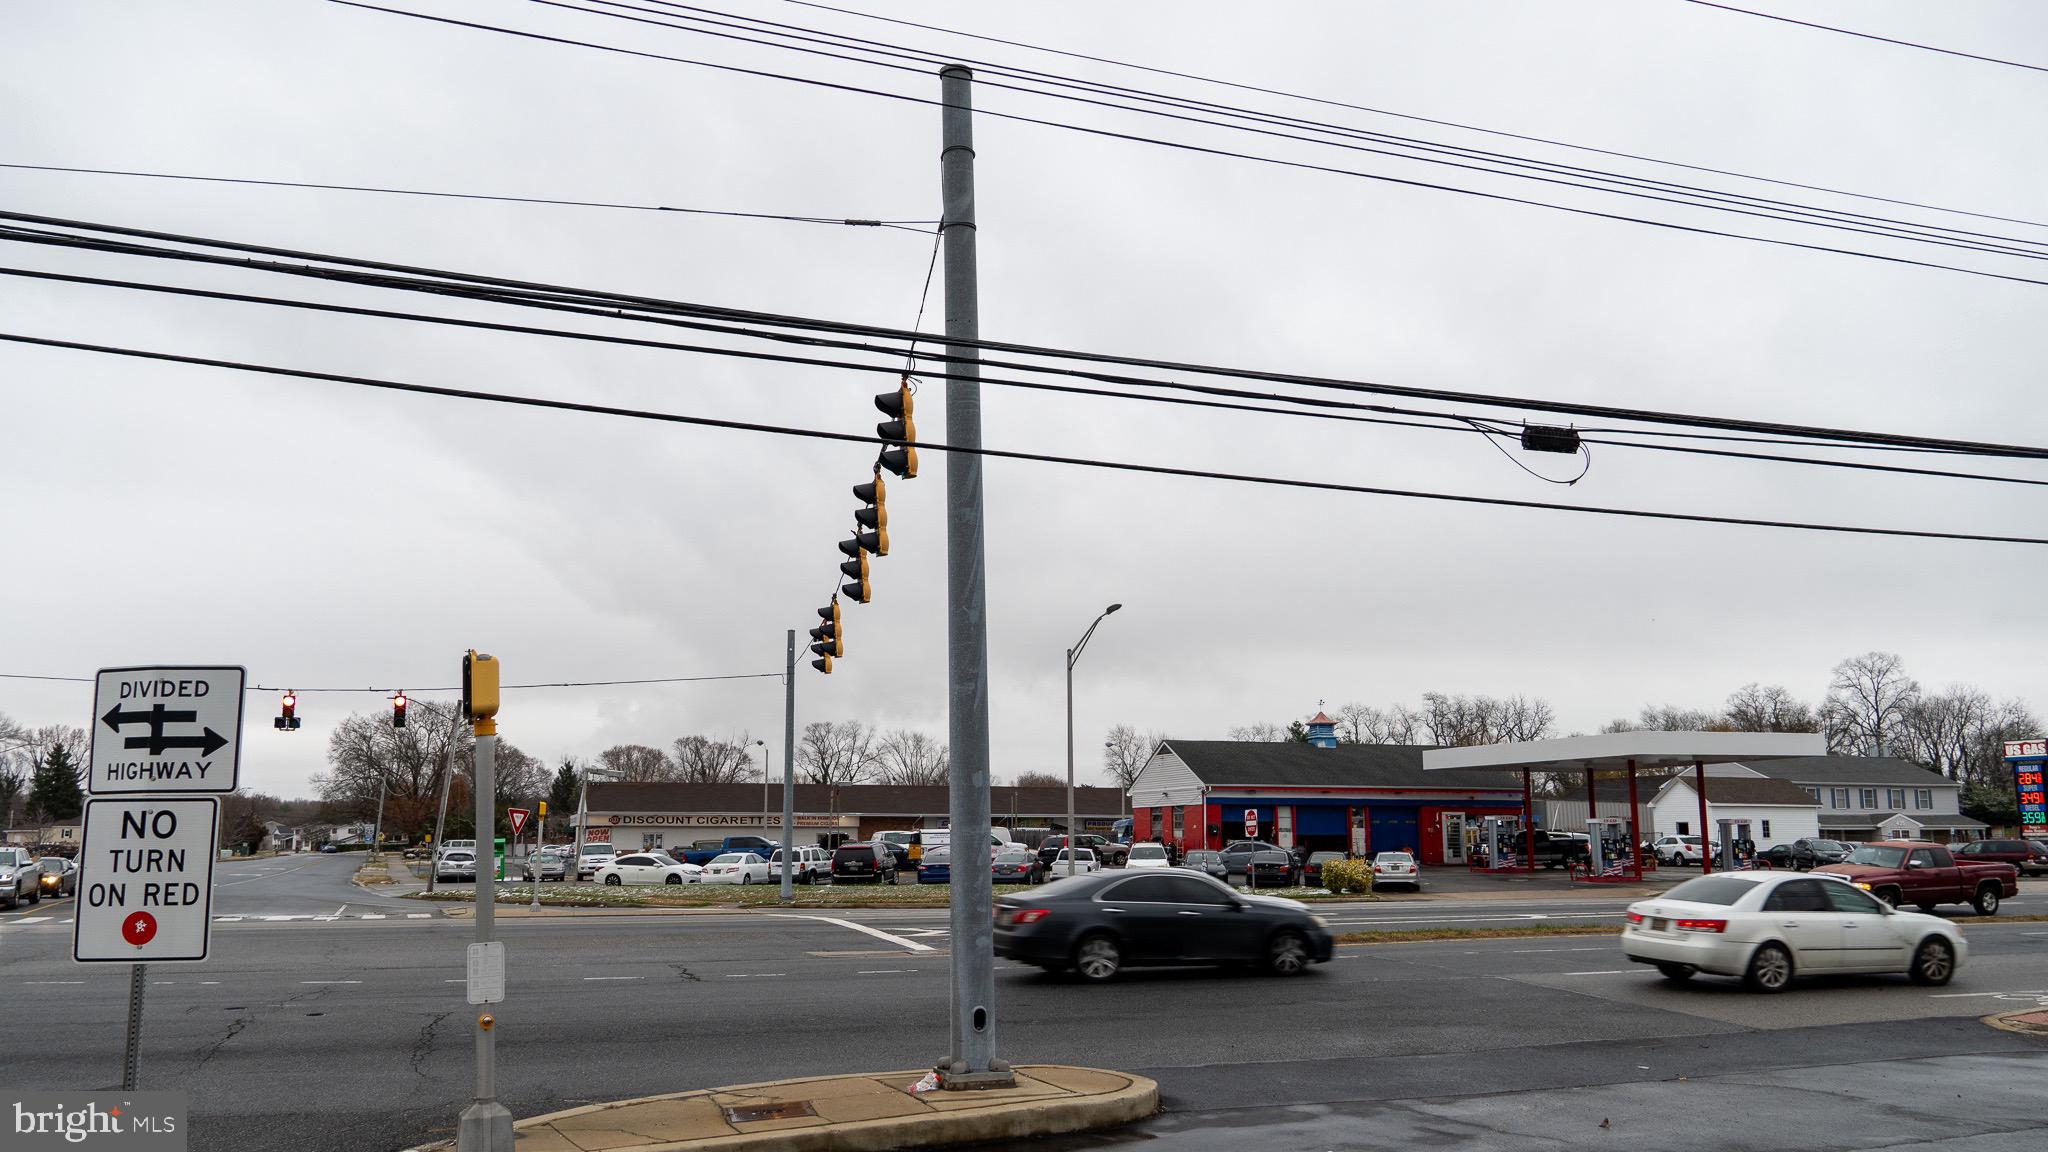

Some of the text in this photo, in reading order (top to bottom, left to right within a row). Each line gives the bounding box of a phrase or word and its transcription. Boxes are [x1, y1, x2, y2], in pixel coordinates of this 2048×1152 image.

[120, 680, 210, 699] DIVIDED
[2005, 743, 2046, 756] US GAS
[107, 761, 212, 781] HIGHWAY
[2023, 784, 2038, 792] SUPER
[2024, 804, 2040, 812] DIESEL
[121, 809, 177, 839] NO
[623, 815, 693, 825] DISCOUNT
[696, 815, 781, 825] CIGARETTES
[586, 835, 610, 843] OPEN
[587, 828, 610, 837] NOW
[109, 849, 186, 873] TURN
[88, 882, 200, 908] ON RED
